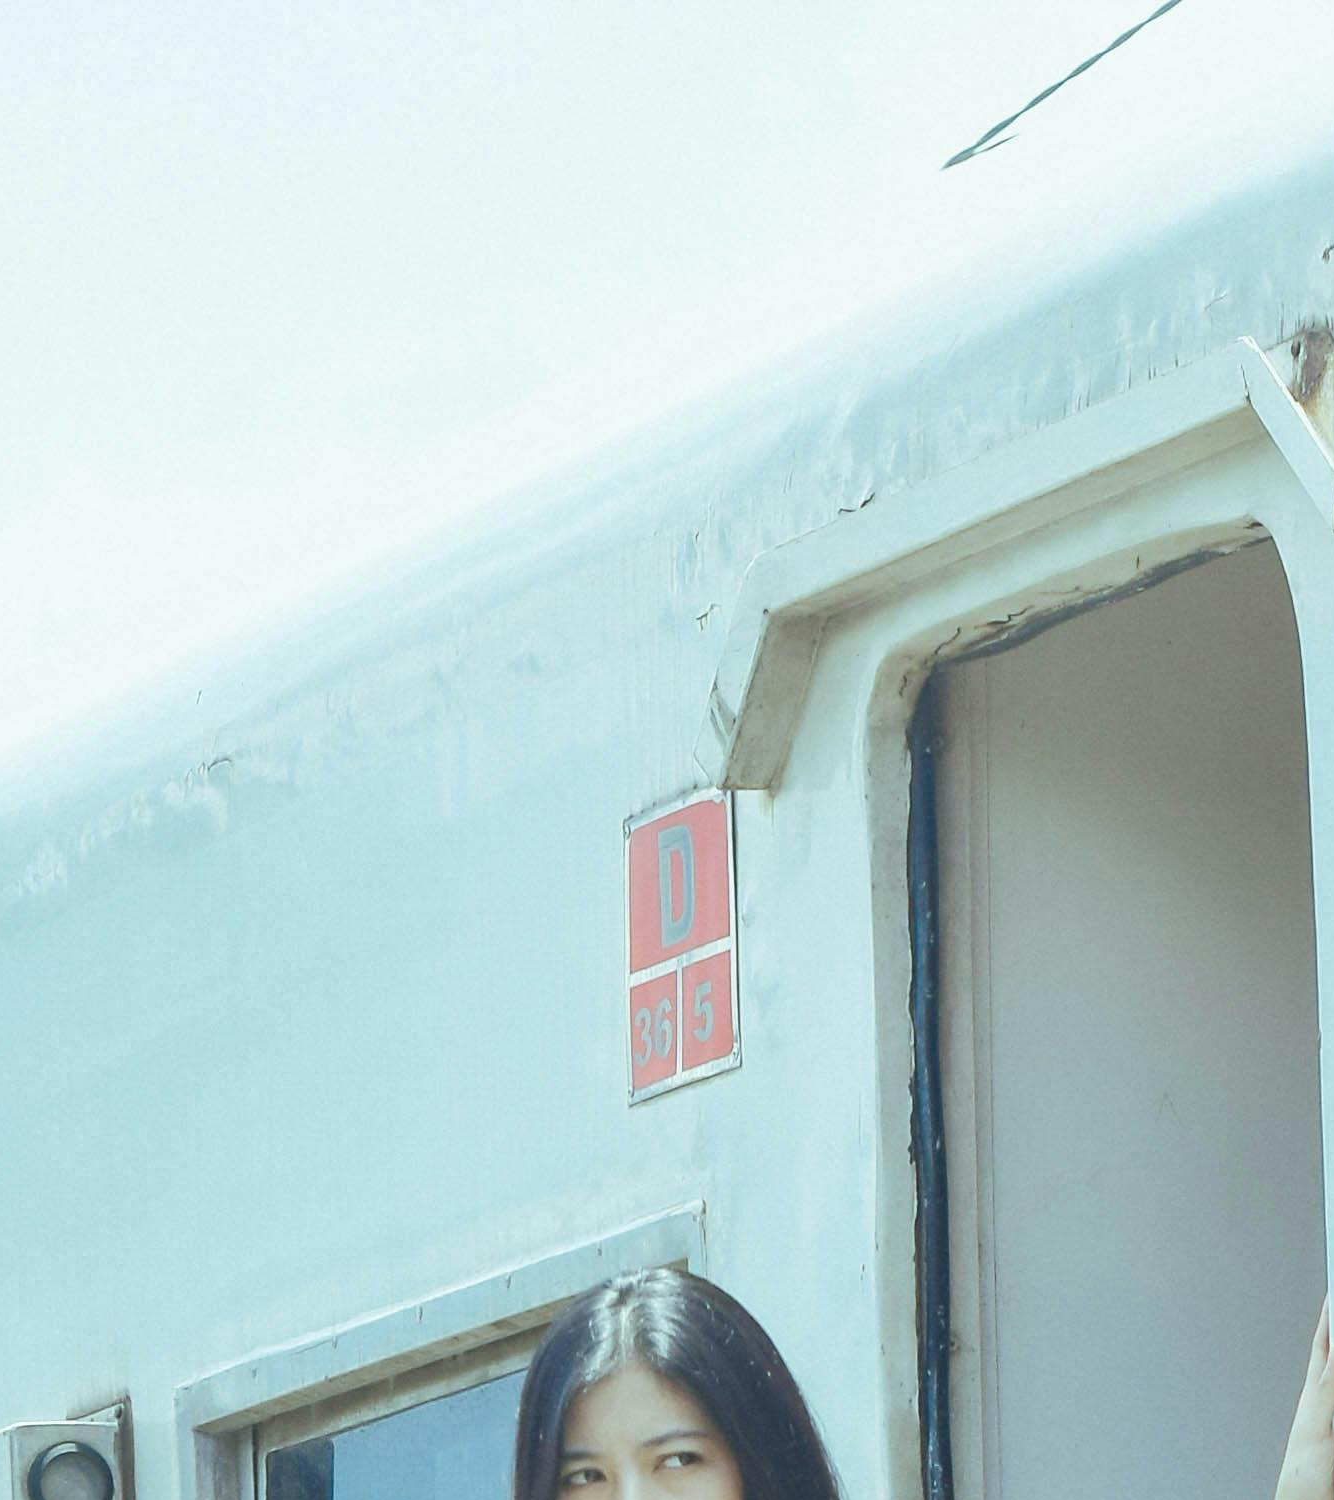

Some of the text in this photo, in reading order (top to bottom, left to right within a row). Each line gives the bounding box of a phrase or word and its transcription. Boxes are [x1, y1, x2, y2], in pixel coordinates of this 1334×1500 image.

[657, 823, 696, 949] D
[633, 997, 674, 1068] 36
[692, 979, 715, 1043] 5
